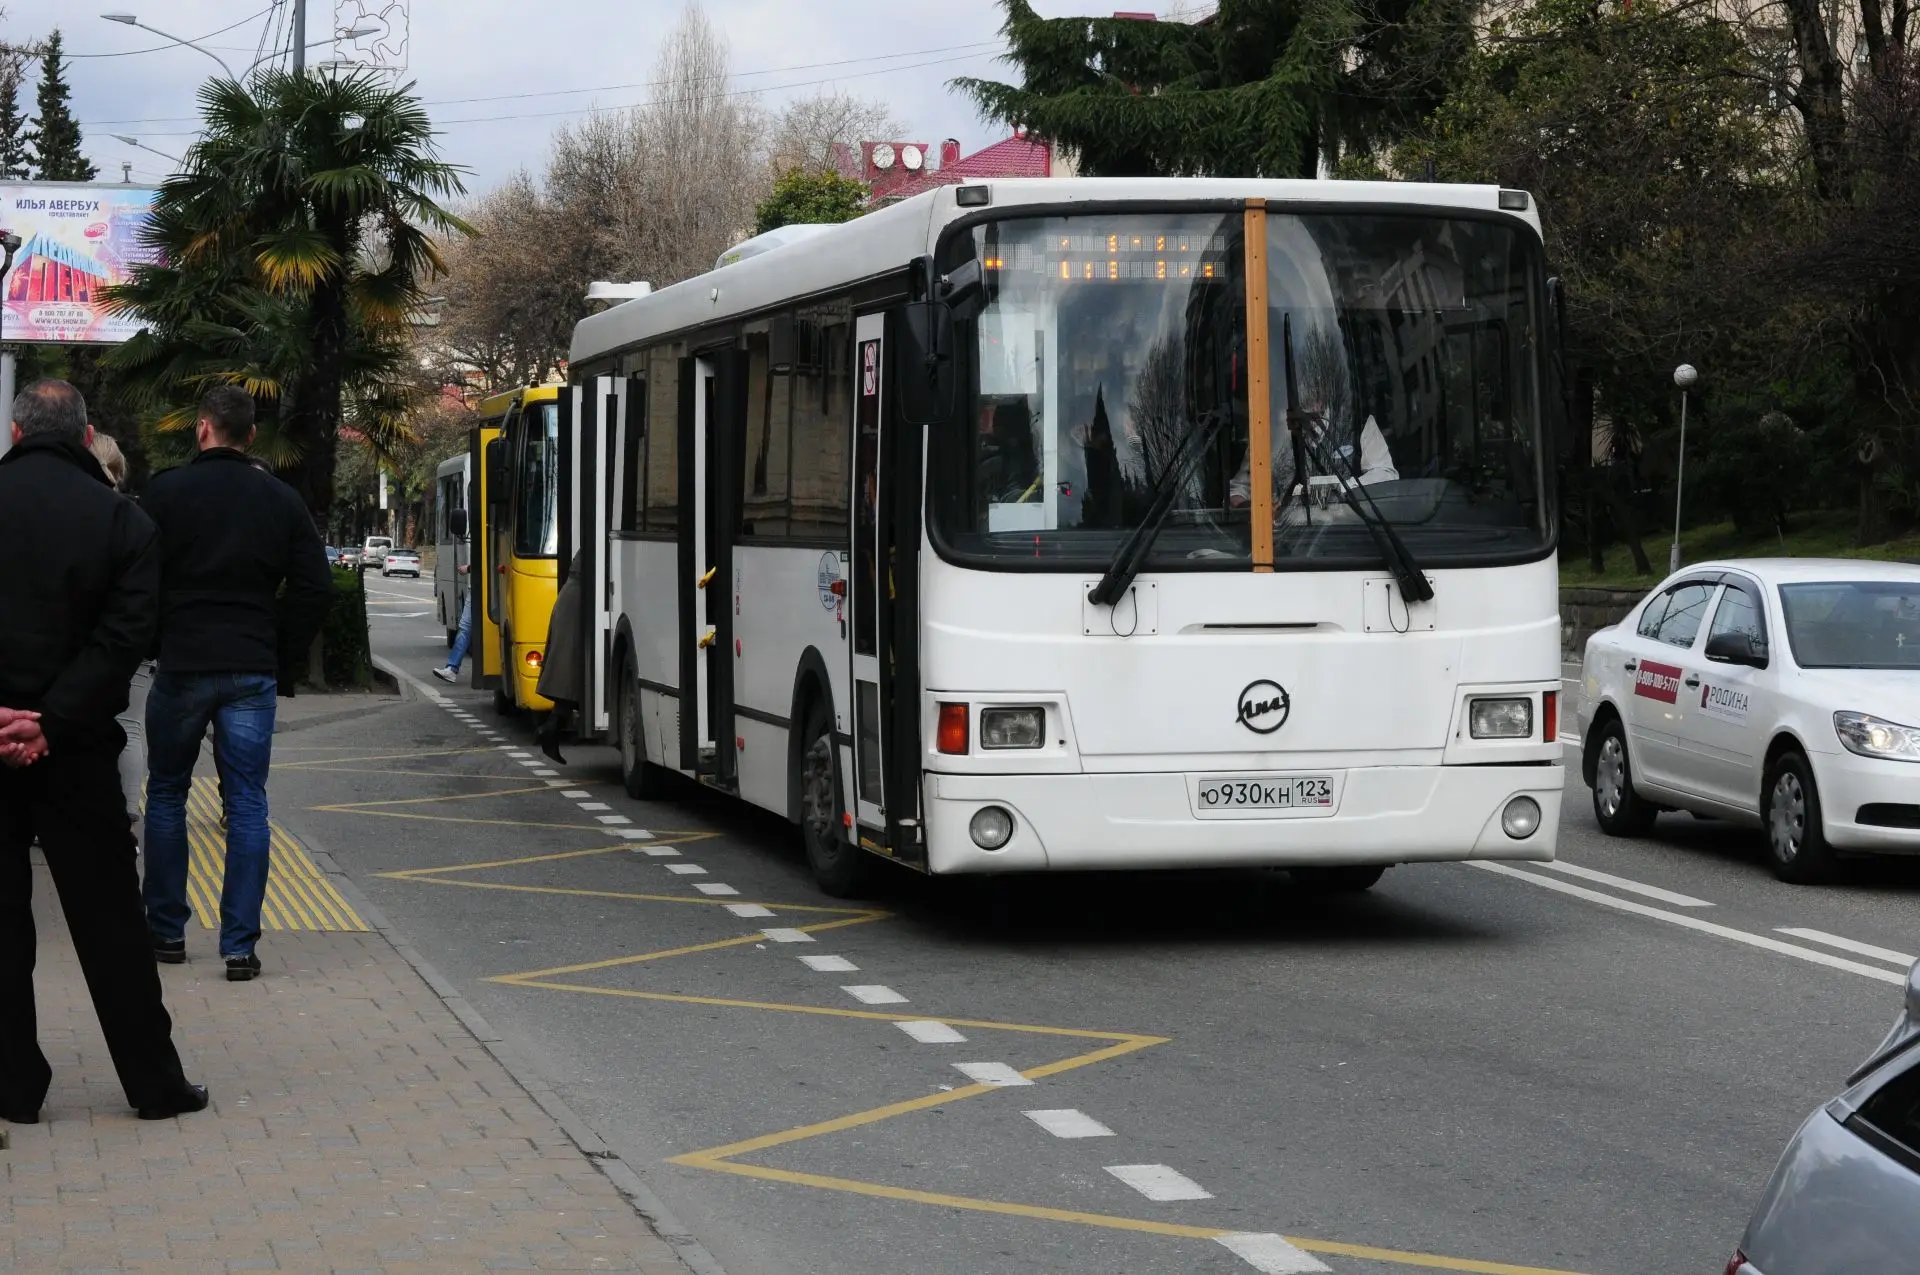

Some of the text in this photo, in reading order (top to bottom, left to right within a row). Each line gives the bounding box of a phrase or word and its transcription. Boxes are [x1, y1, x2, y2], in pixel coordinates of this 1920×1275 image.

[16, 199, 99, 211] ИЛЬЯ АВЕРБУХ
[1709, 686, 1749, 711] РОДИНА
[1296, 780, 1328, 797] 123
